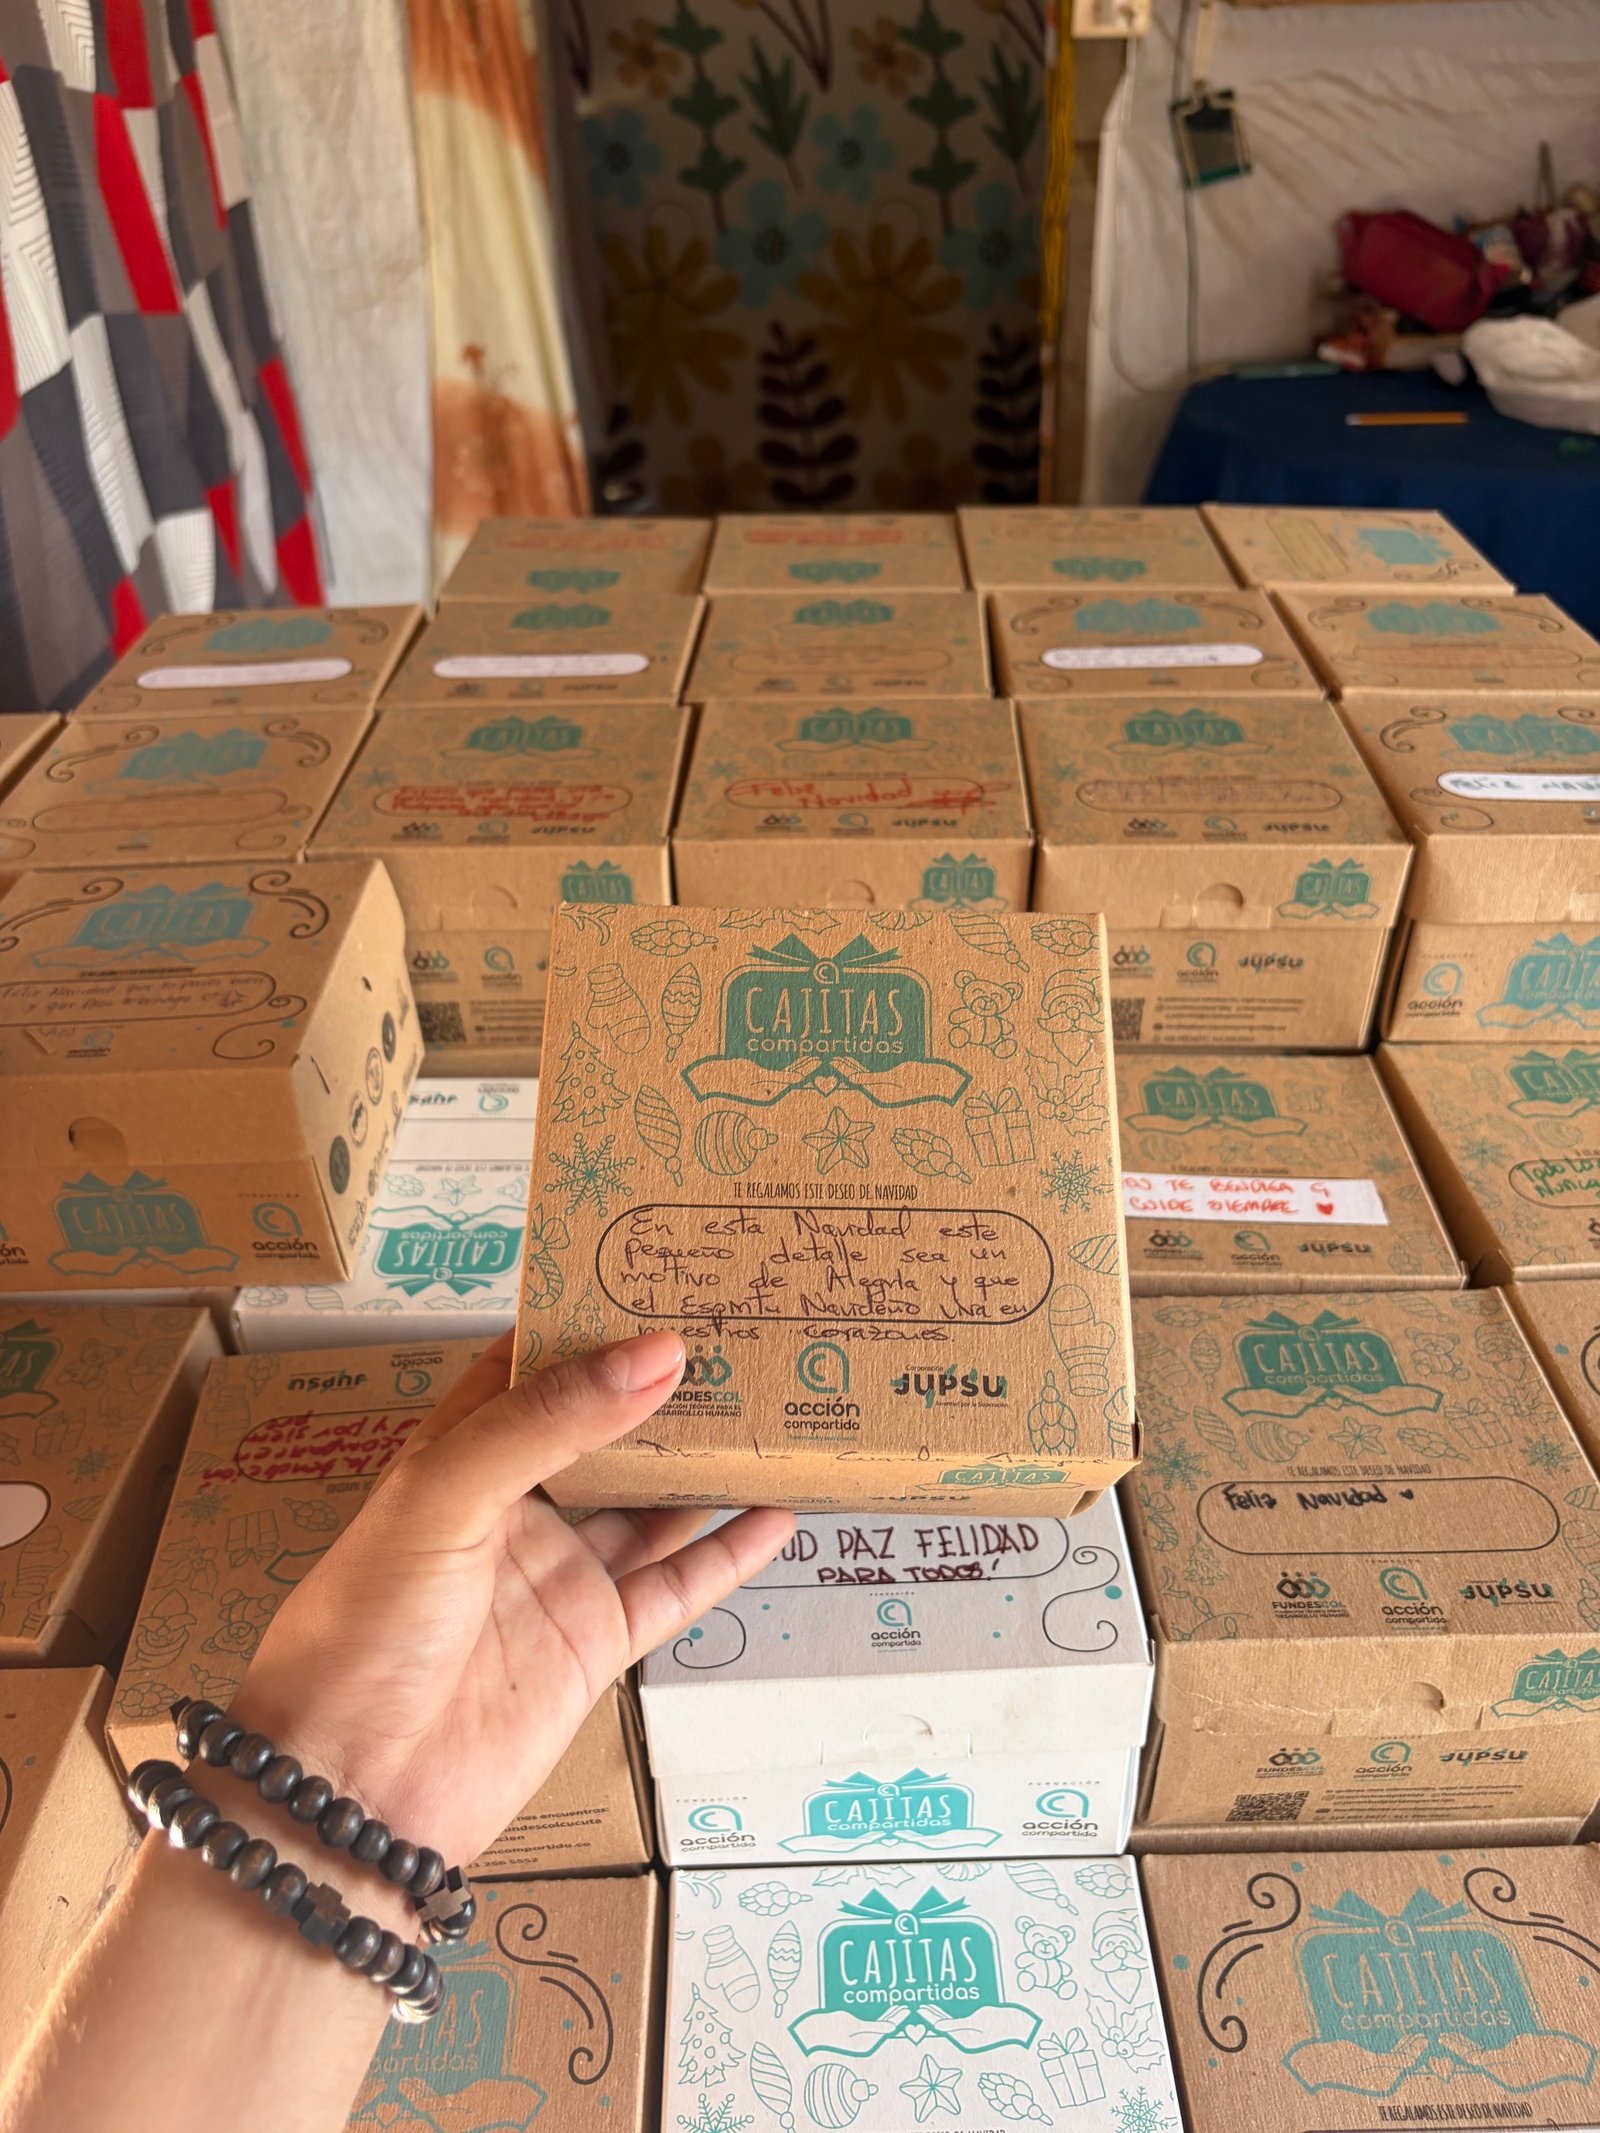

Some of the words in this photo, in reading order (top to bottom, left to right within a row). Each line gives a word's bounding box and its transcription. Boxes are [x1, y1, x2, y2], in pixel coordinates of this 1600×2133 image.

[746, 986, 903, 1039] CAJITAS
[747, 1036, 904, 1056] compartidas
[733, 1182, 742, 1198] TE
[746, 1182, 800, 1199] REGALAMOS
[805, 1183, 824, 1200] ESTE
[828, 1183, 855, 1200] DESEO
[860, 1184, 871, 1200] DE
[875, 1184, 917, 1201] NAVIDAD
[71, 1203, 186, 1235] CAJITAS
[630, 1208, 674, 1236] En
[704, 1208, 765, 1237] esta
[793, 1205, 911, 1239] Navidad
[938, 1211, 1000, 1241] este
[252, 1238, 318, 1251] acción
[394, 1239, 506, 1268] CAJITAS
[769, 1232, 868, 1265] detalle
[899, 1248, 950, 1264] sea
[970, 1248, 1007, 1261] un
[620, 1263, 720, 1287] motivo
[748, 1262, 788, 1289] de
[974, 1274, 1020, 1300] que
[631, 1295, 656, 1313] el
[1000, 1303, 1027, 1315] en
[1253, 1341, 1379, 1374] CAJITAS
[905, 1364, 944, 1372] Corporación
[893, 1372, 1007, 1398] JUPSU
[1264, 1371, 1385, 1387] compartidas
[671, 1391, 743, 1402] NDESCOL
[784, 1396, 859, 1417] acción
[706, 1410, 742, 1418] HUMANO
[784, 1418, 860, 1432] compartida
[1222, 1483, 1277, 1511] Feliz
[1297, 1483, 1388, 1511] Navidad
[837, 1525, 895, 1561] PAZ
[914, 1522, 1040, 1559] FELIDAD
[817, 1566, 896, 1584] PARA
[1461, 1580, 1555, 1602] JUPSU
[1381, 1602, 1444, 1616] acción
[871, 1627, 921, 1640] acción
[871, 1640, 922, 1648] compartida
[1525, 1669, 1600, 1690] CAJITA
[1442, 1748, 1528, 1766] JUPSU
[1355, 1763, 1412, 1774] acción
[824, 1792, 953, 1825] CAJITAS
[504, 1818, 603, 1833] undescolcucuta
[826, 1817, 952, 1833] compartidas
[1022, 1818, 1098, 1830] acción
[680, 1832, 756, 1846] acción
[681, 1842, 757, 1853] compartida
[839, 1936, 978, 1988] CAJITAS
[1323, 1948, 1502, 2012] CAJITAS
[843, 1982, 981, 2006] compartidas
[1341, 2007, 1512, 2036] compartidas
[1493, 2102, 1533, 2119] NAVIDAD
